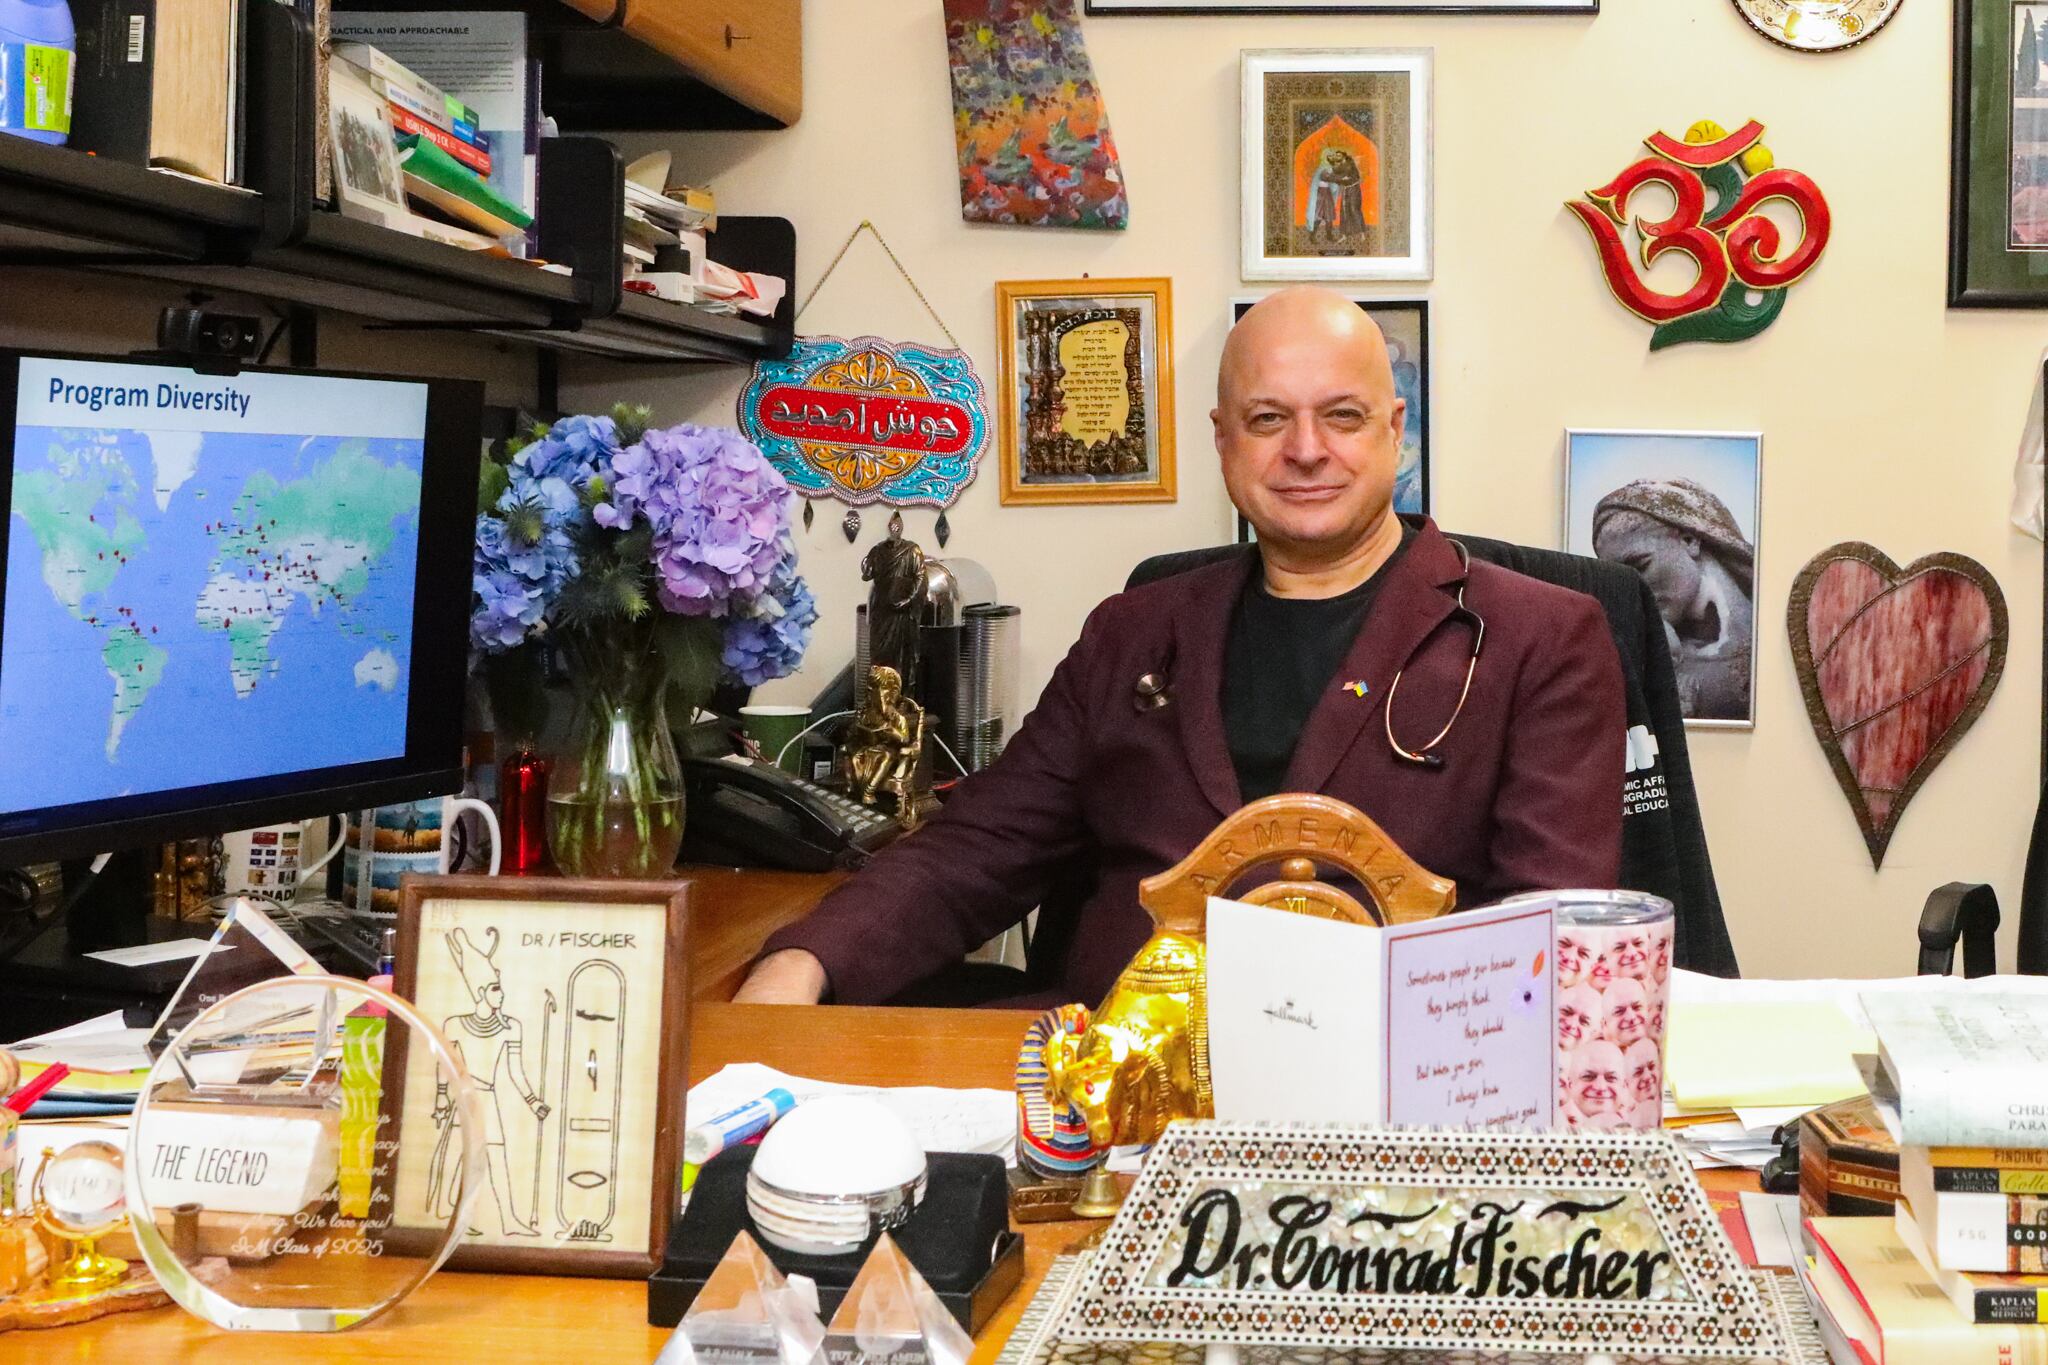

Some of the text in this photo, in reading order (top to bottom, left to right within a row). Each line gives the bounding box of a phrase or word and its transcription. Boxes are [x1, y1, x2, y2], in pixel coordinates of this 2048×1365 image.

[376, 27, 397, 35] AND
[399, 26, 471, 35] APPROACHABLE
[49, 377, 251, 418] Program Diversity
[870, 401, 959, 448] خوش
[1190, 817, 1406, 898] ARMENIA
[521, 932, 544, 948] DR
[559, 932, 637, 949] FISCHER
[1263, 1007, 1319, 1030] Hallmark
[2007, 1104, 2048, 1116] CHRI
[2008, 1119, 2047, 1131] PARA
[1993, 1148, 2043, 1164] FINDING
[151, 1143, 268, 1187] THE LEGEND
[1952, 1171, 1998, 1180] KAPLAN
[1952, 1184, 1998, 1192] MEDICINE
[294, 1211, 326, 1230] We
[329, 1212, 356, 1229] love
[355, 1212, 394, 1236] you!
[271, 1236, 310, 1255] Class
[311, 1238, 329, 1260] of
[331, 1237, 384, 1258] 2025
[1990, 1296, 2036, 1306] KAPLAN
[1990, 1310, 2036, 1318] MEDICINE
